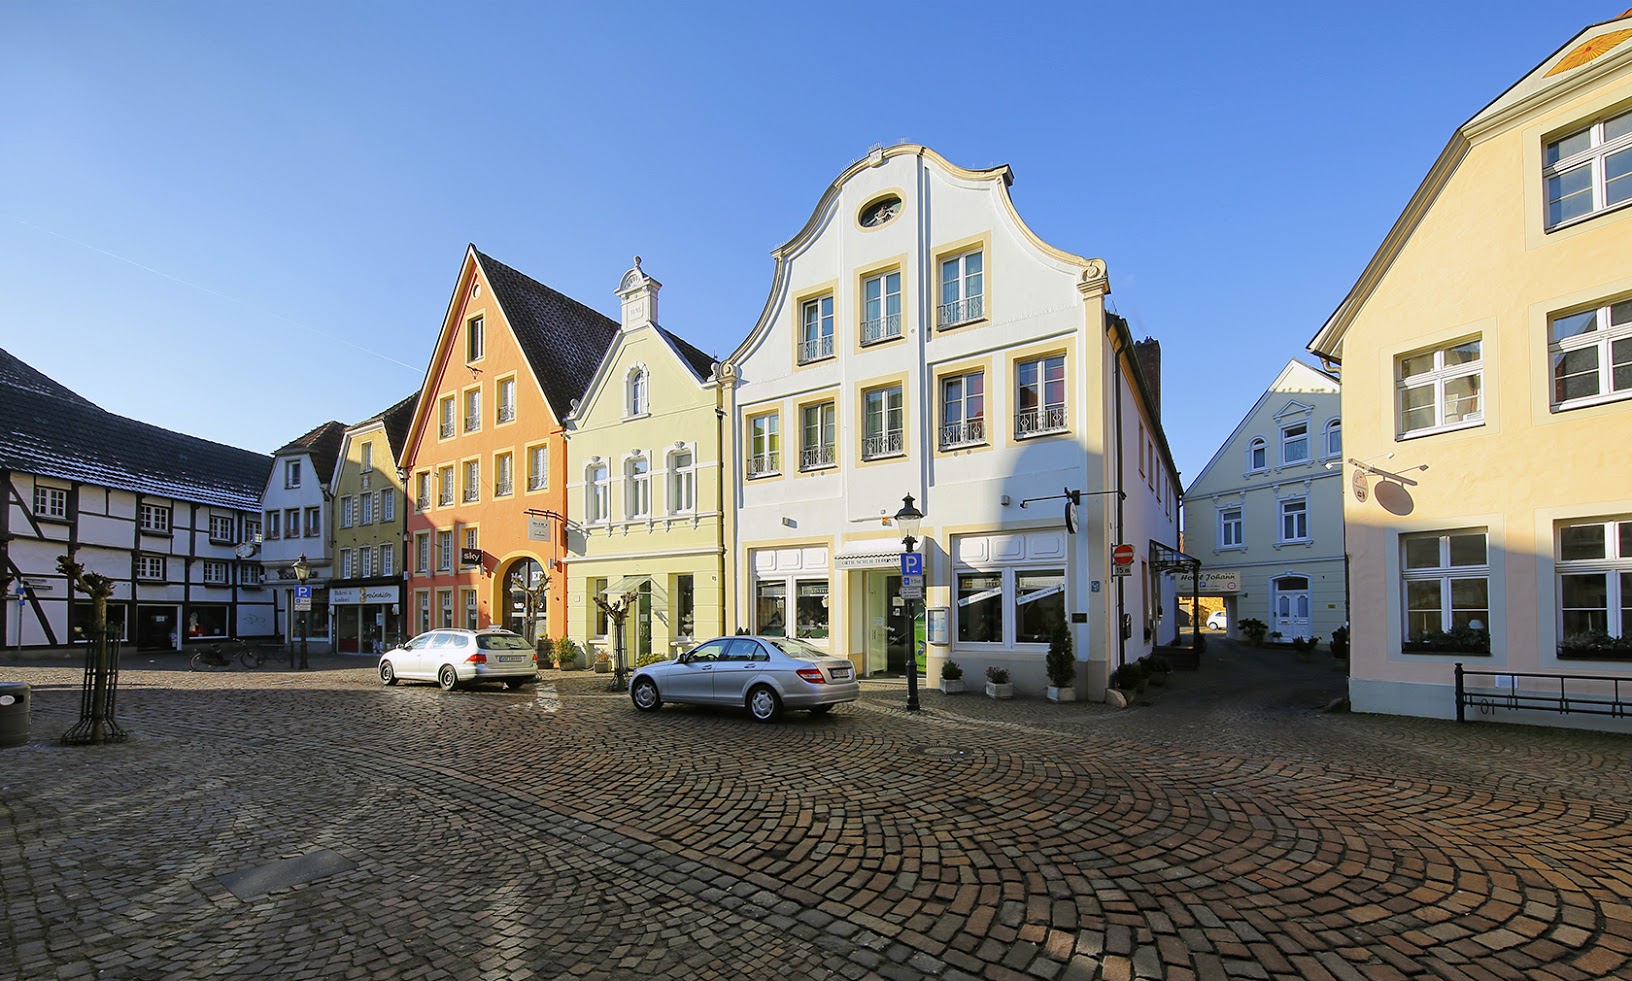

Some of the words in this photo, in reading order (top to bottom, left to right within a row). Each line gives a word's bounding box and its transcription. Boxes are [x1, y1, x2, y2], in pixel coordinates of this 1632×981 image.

[463, 552, 480, 562] sky
[906, 556, 918, 573] P
[1205, 573, 1236, 581] Johann
[298, 587, 308, 597] P
